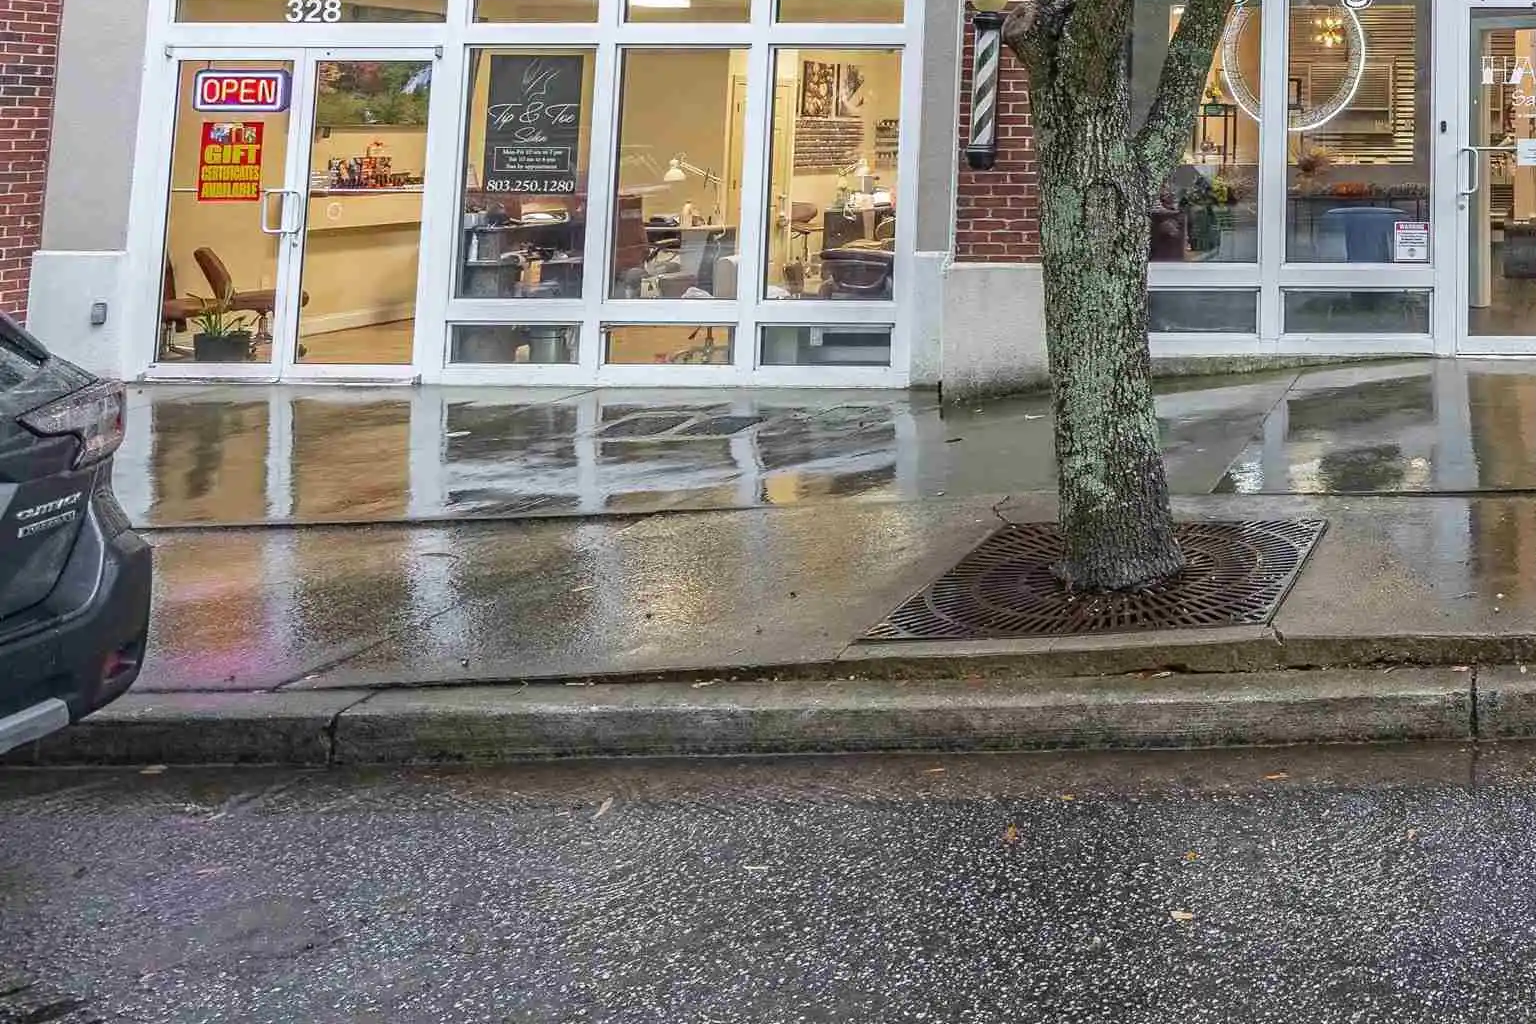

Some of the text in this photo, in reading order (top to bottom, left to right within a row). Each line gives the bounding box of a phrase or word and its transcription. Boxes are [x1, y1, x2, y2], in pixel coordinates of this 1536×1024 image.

[203, 79, 276, 104] OPEN
[487, 103, 523, 130] Tip
[204, 144, 261, 164] GIFT
[487, 180, 574, 192] 803.250.1280
